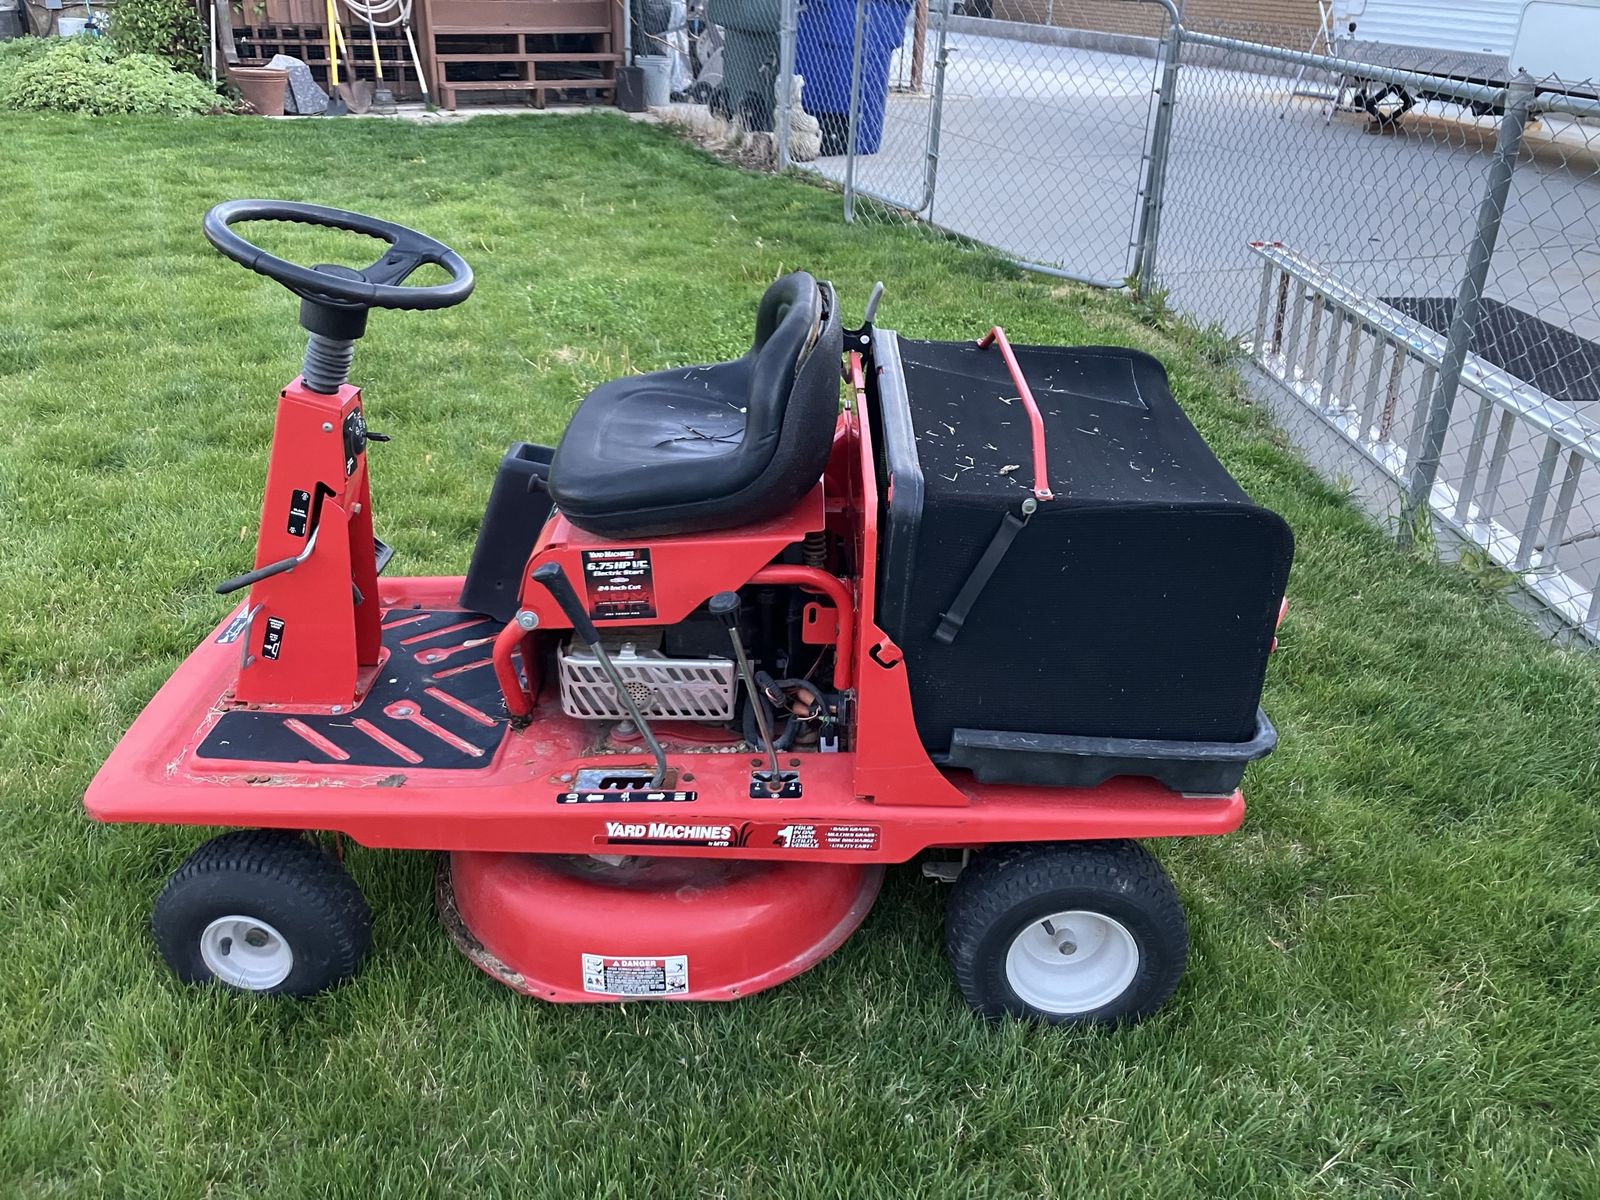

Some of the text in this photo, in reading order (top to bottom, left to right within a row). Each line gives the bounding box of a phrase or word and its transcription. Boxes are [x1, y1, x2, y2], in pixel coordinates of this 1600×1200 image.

[586, 562, 614, 570] 6.75
[614, 561, 631, 570] HP
[606, 822, 732, 840] YARD MACHINES
[778, 826, 794, 848] 1
